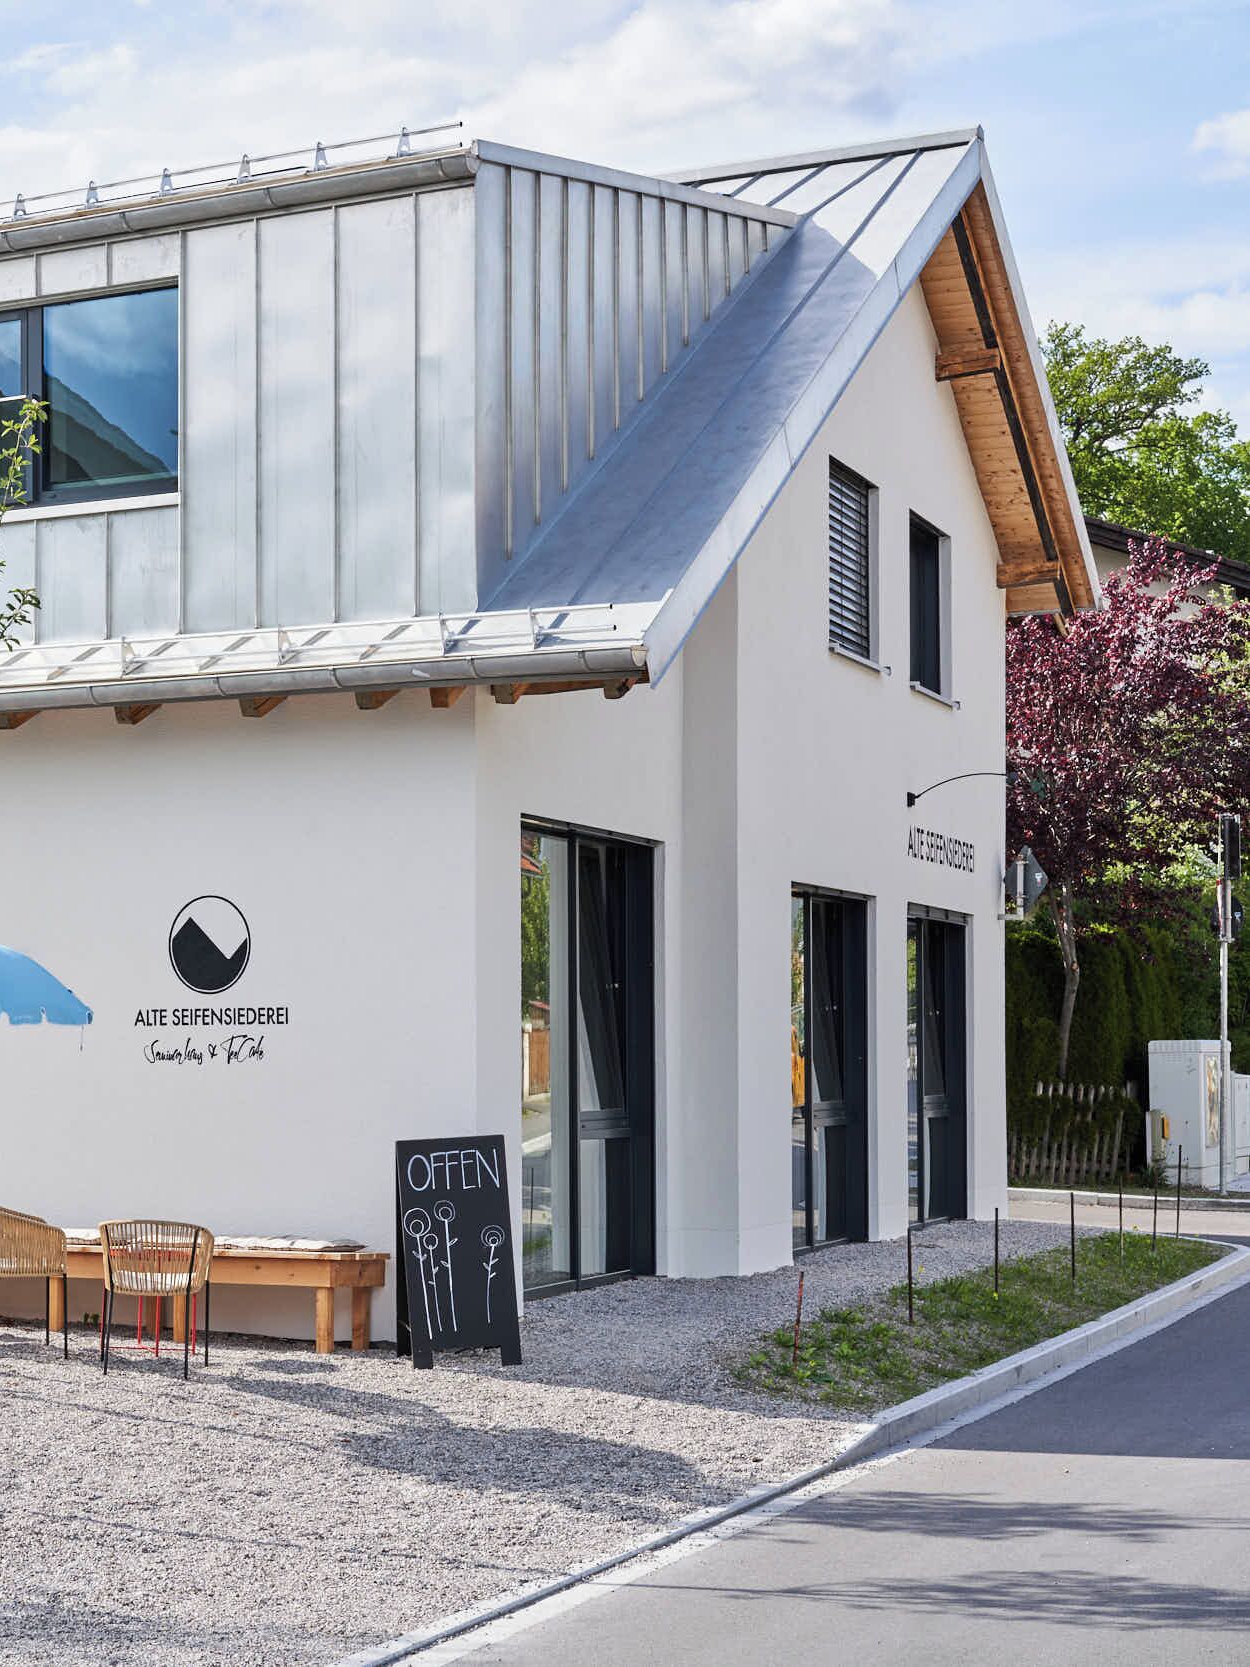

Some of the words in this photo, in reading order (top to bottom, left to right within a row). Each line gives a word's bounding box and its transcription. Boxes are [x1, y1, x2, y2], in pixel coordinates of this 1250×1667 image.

[907, 824, 924, 860] ALTE
[926, 830, 975, 873] SEIFENSIEDEREI
[135, 1009, 167, 1026] ALTE
[172, 1007, 289, 1026] SEIFENSIEDEREI
[207, 1043, 218, 1059] &
[407, 1148, 500, 1191] OFFEN
